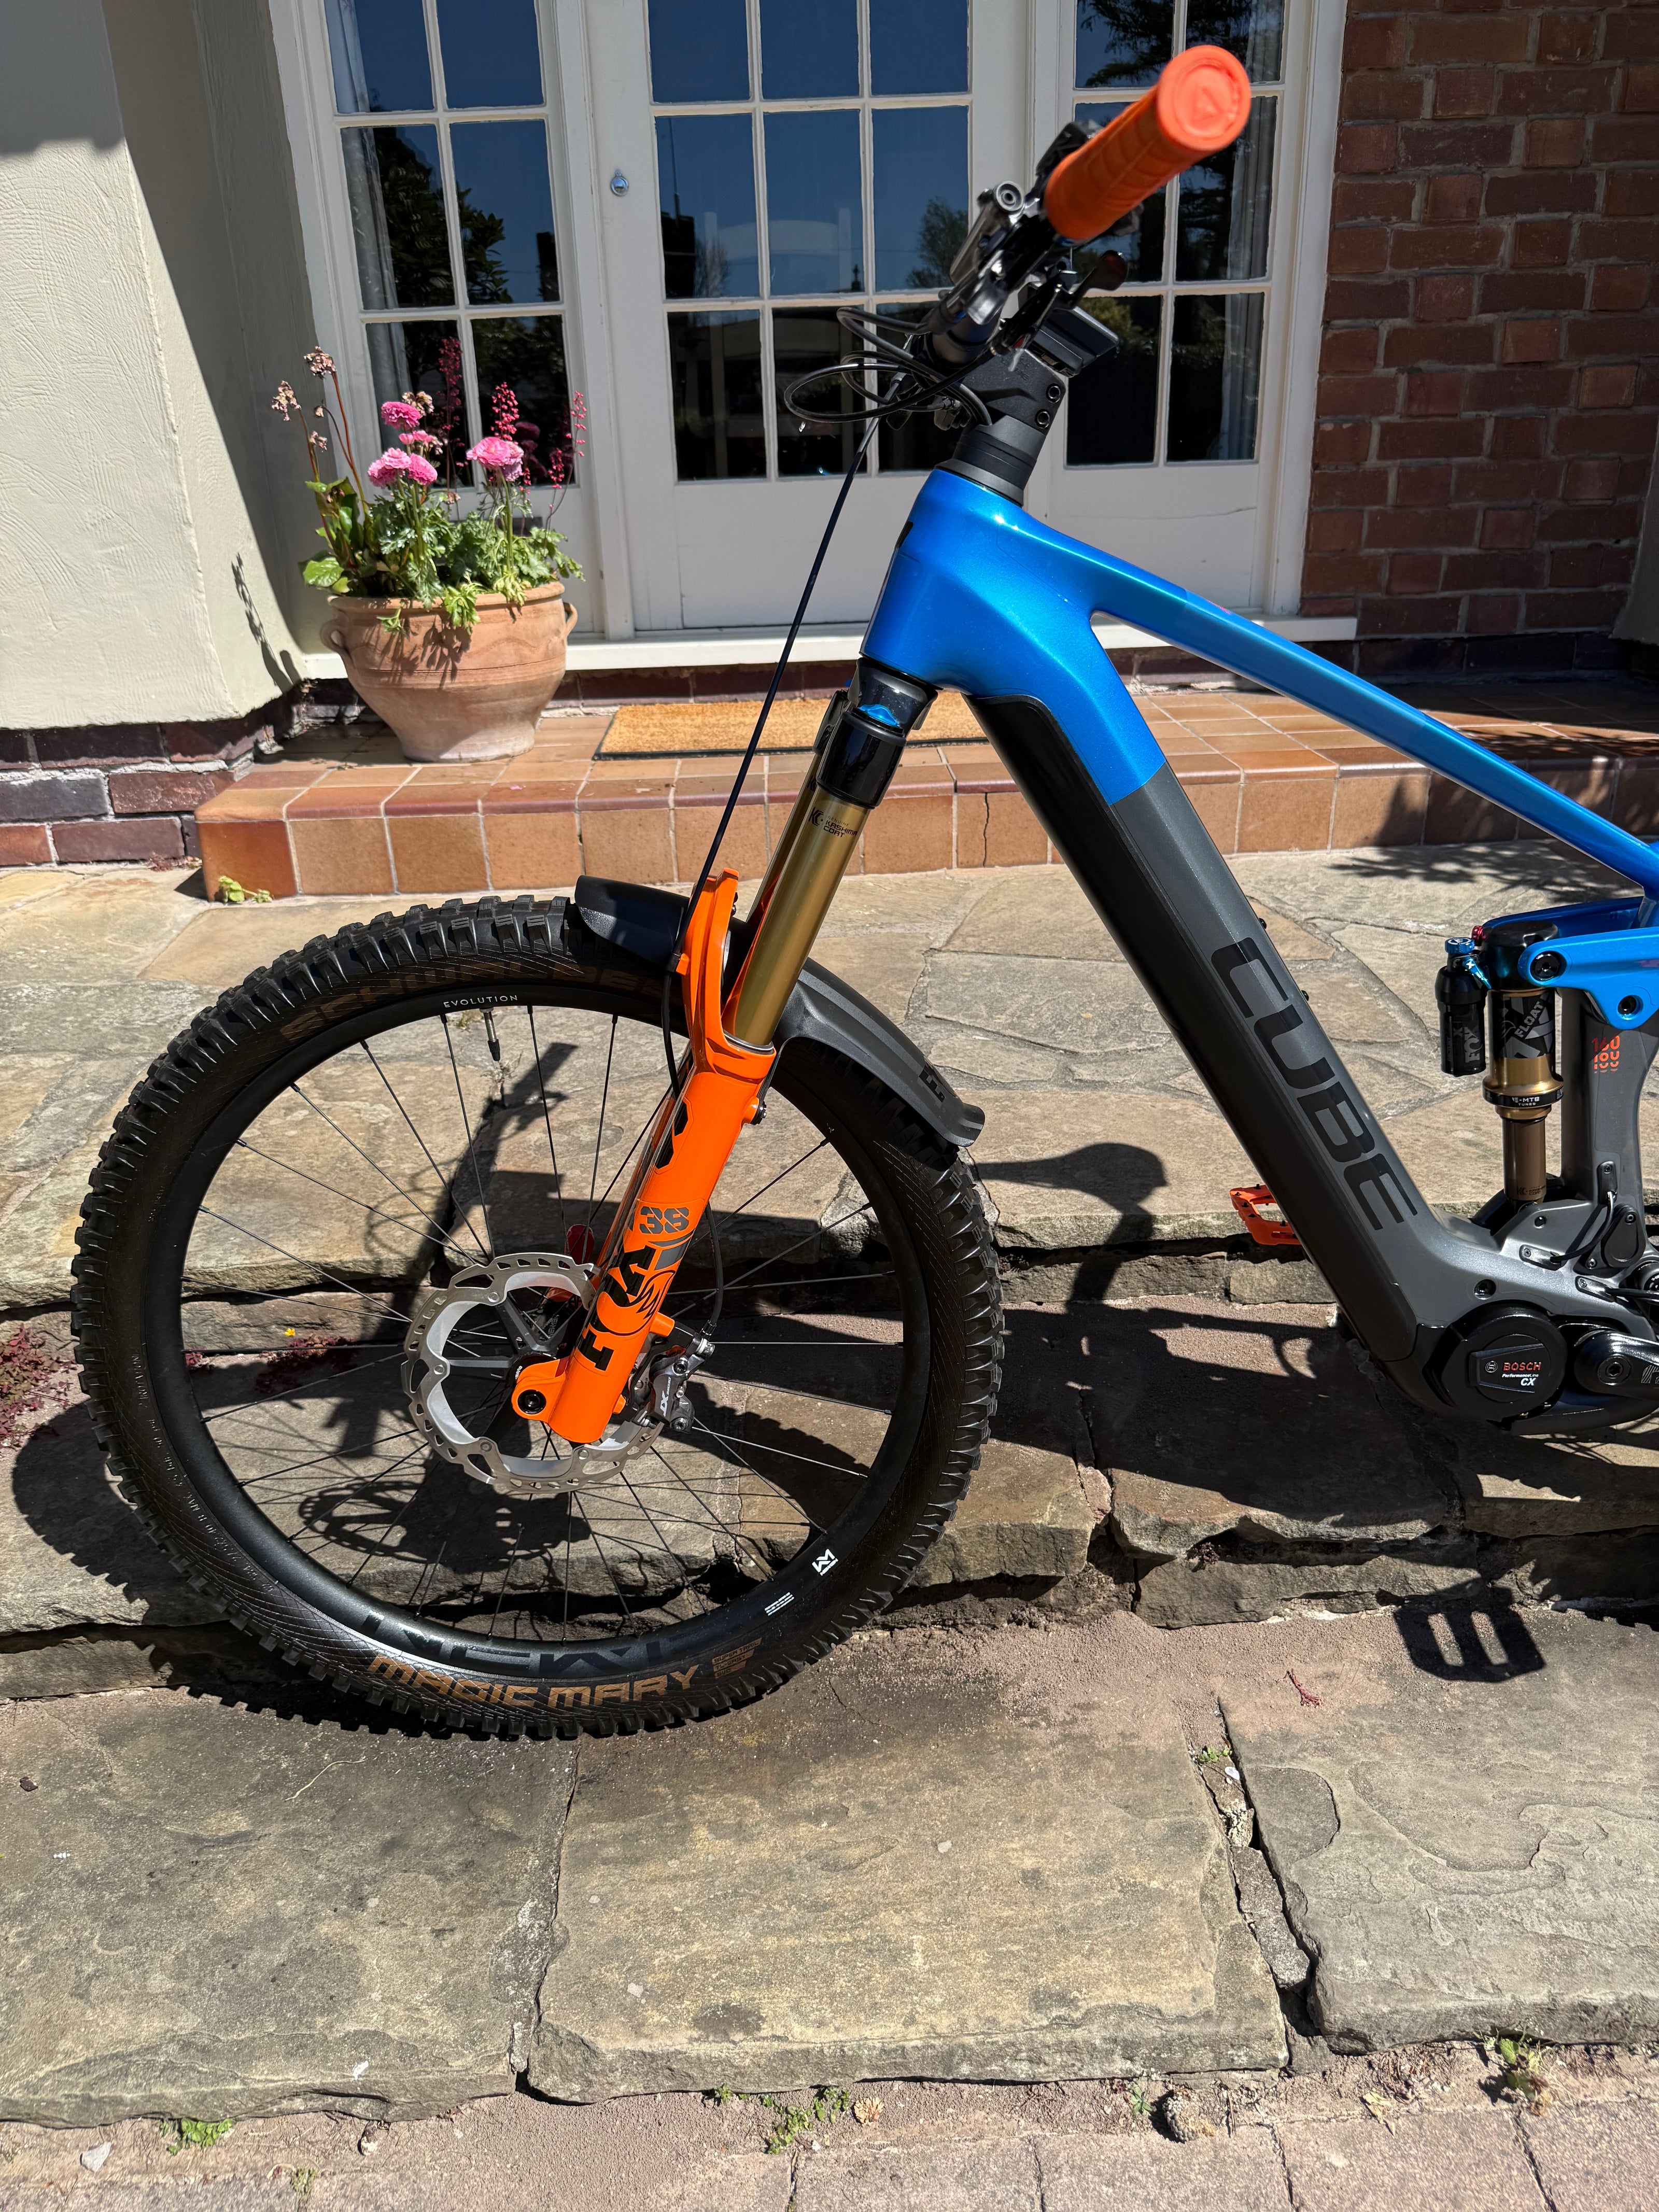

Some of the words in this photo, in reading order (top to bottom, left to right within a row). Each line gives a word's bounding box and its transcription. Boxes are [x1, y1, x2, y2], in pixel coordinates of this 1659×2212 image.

[823, 825, 845, 838] COAT
[825, 821, 858, 836] KASHIMA
[443, 994, 518, 1008] EVOLUTION
[1513, 1001, 1544, 1038] FLOAT
[1464, 1026, 1483, 1063] FOX
[1211, 937, 1418, 1231] CUBE
[640, 1206, 690, 1234] 38
[575, 1246, 674, 1372] FOX
[1503, 1361, 1542, 1371] BOSCH
[1520, 1377, 1536, 1386] CX
[660, 1390, 668, 1417] XT
[367, 1655, 539, 1708] MAGIC
[550, 1665, 700, 1708] MARY
